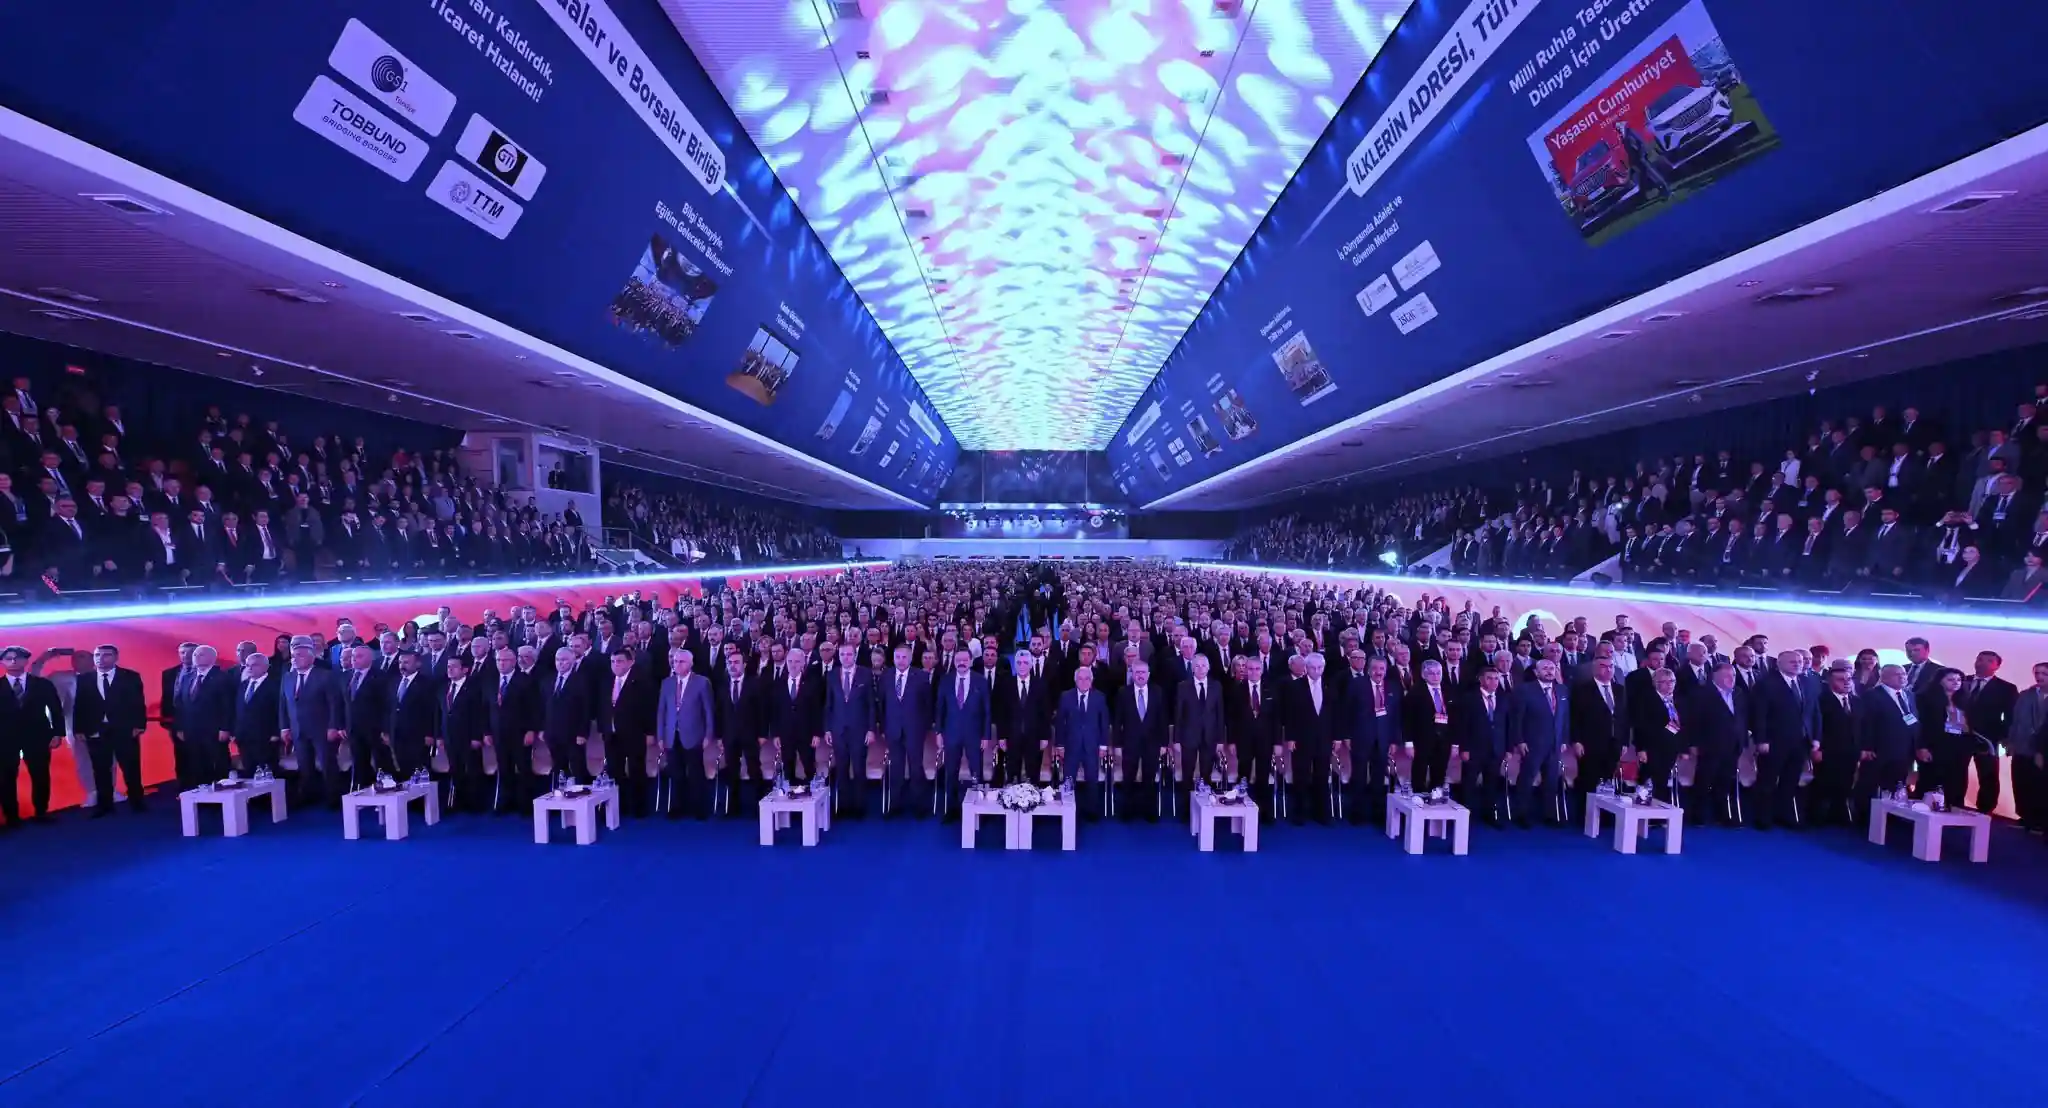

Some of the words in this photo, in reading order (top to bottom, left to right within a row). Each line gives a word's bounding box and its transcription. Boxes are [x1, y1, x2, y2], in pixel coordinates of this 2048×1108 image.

[485, 40, 543, 103] Hızlandı!
[496, 15, 553, 86] Kaldırdık,
[1508, 60, 1537, 94] Milli
[1535, 26, 1577, 69] Ruhla
[1528, 64, 1573, 108] Dünya
[1569, 38, 1600, 69] İçin
[386, 71, 408, 93] GS1
[1351, 111, 1408, 185] İLKLERİN
[1408, 31, 1476, 124] ADRESİ,
[1550, 111, 1599, 149] Yaşasın
[1598, 49, 1677, 115] Cumhuriyet
[322, 115, 361, 143] BRIDGING
[362, 139, 398, 164] BORDERS
[331, 99, 407, 154] TOBBUND
[608, 41, 628, 77] ve
[629, 63, 687, 144] Borsalar
[685, 131, 722, 186] Birliği
[473, 189, 505, 219] TTM
[655, 200, 678, 228] Eğitim
[677, 221, 706, 253] Gelecekle
[682, 202, 699, 225] Bilgi
[1373, 202, 1395, 227] Adalet
[1393, 195, 1403, 208] ve
[1352, 242, 1376, 267] Güvenin
[1373, 219, 1400, 247] Merkezi
